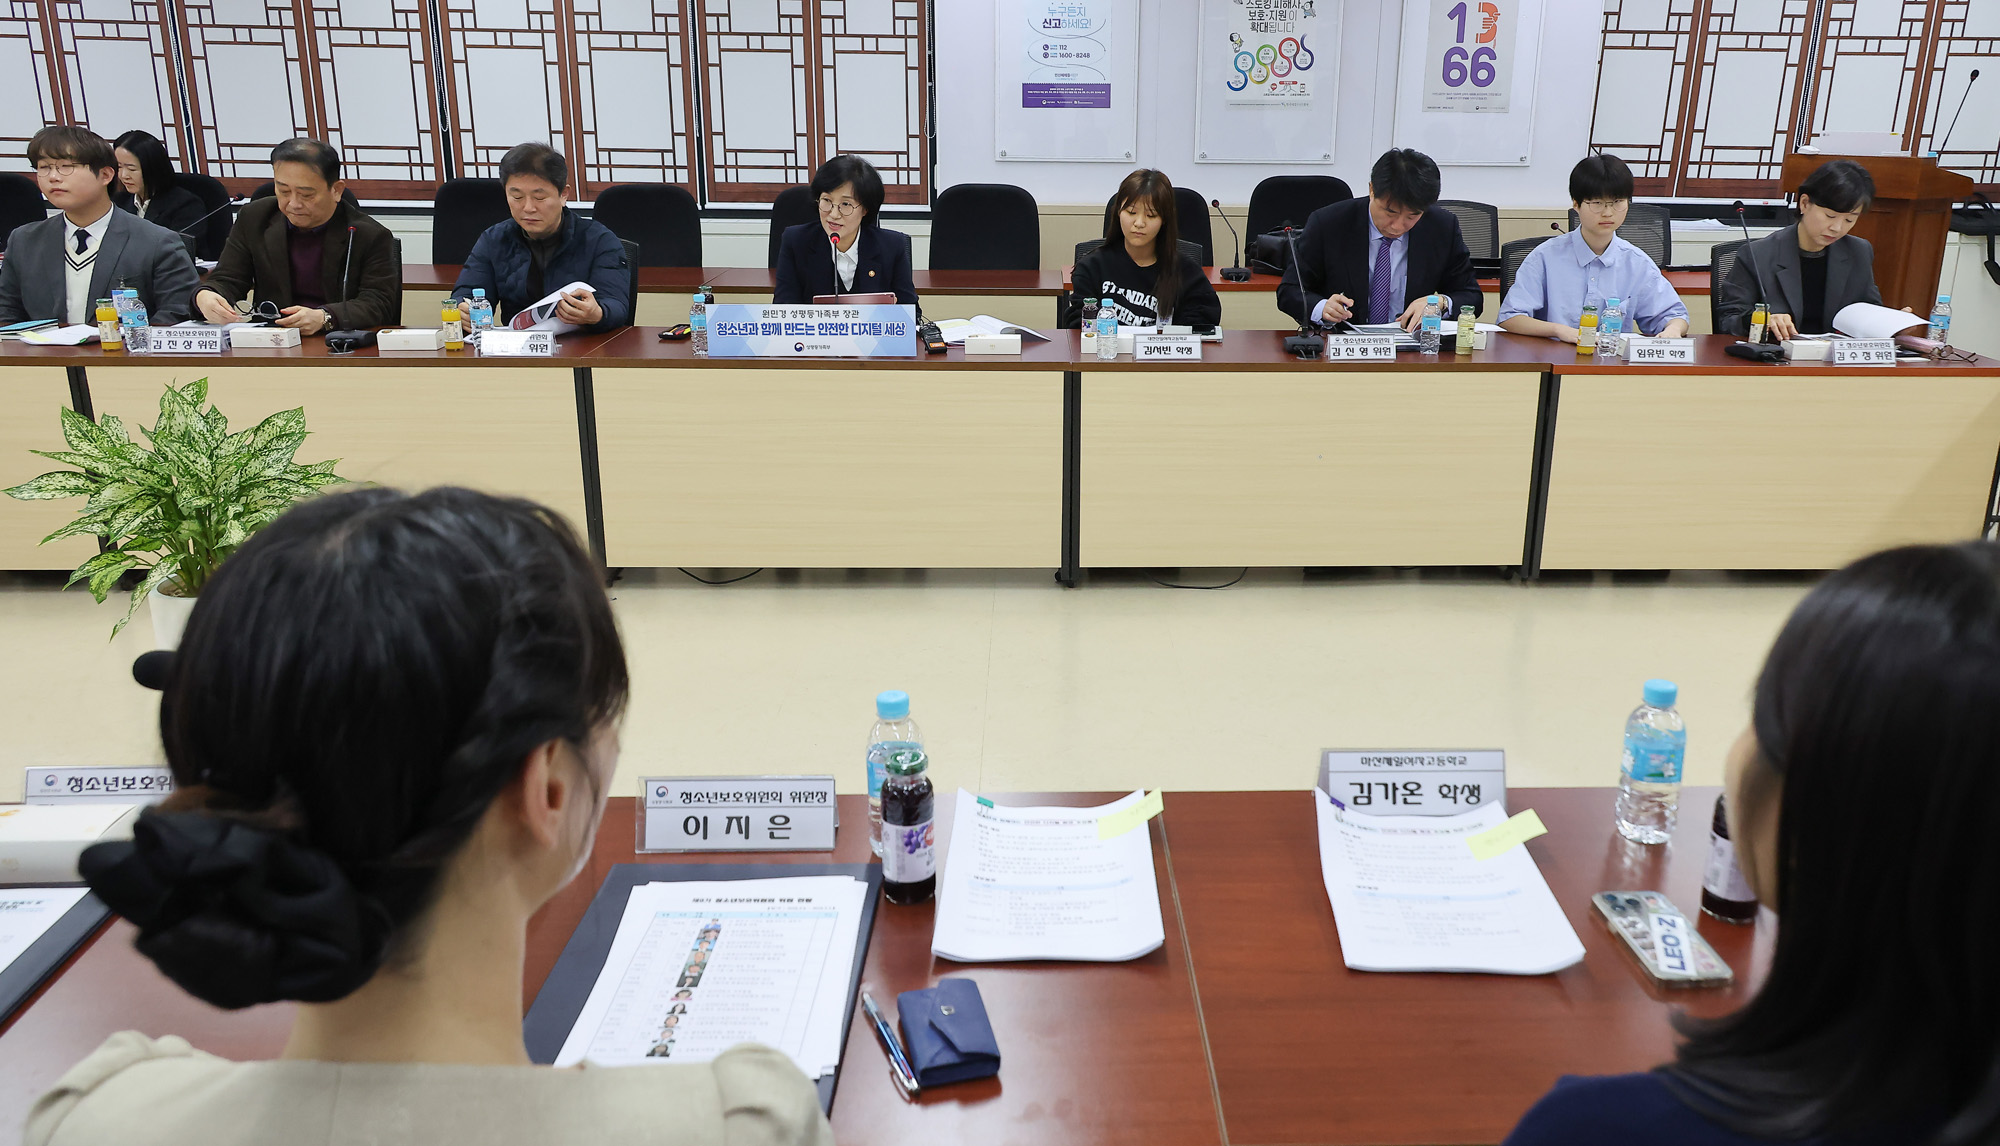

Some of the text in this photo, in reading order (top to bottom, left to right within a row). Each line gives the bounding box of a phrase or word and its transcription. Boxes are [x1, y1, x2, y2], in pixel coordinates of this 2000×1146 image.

[1047, 6, 1086, 17] 누구든지
[1042, 18, 1091, 29] 신고하세요!
[1250, 21, 1294, 33] 확대됩니다
[1442, 46, 1497, 87] 66
[762, 309, 860, 319] 원민경 성평등가족부 장관
[717, 322, 906, 336] 청소년과 함께 만드는 안전한 디지털 세상
[197, 340, 217, 349] 위원
[529, 343, 548, 353] 위원
[1143, 345, 1193, 355] 김서빈 학생
[1373, 346, 1391, 356] 위원
[1637, 349, 1685, 358] 임유빈 학생
[1875, 351, 1893, 360] 위원
[1360, 756, 1467, 767] 마산제일여자고등학교
[67, 776, 172, 793] 청소년보호위
[680, 791, 828, 804] 청소년보호위원회 위원장
[1349, 781, 1481, 805] 김가온 학생
